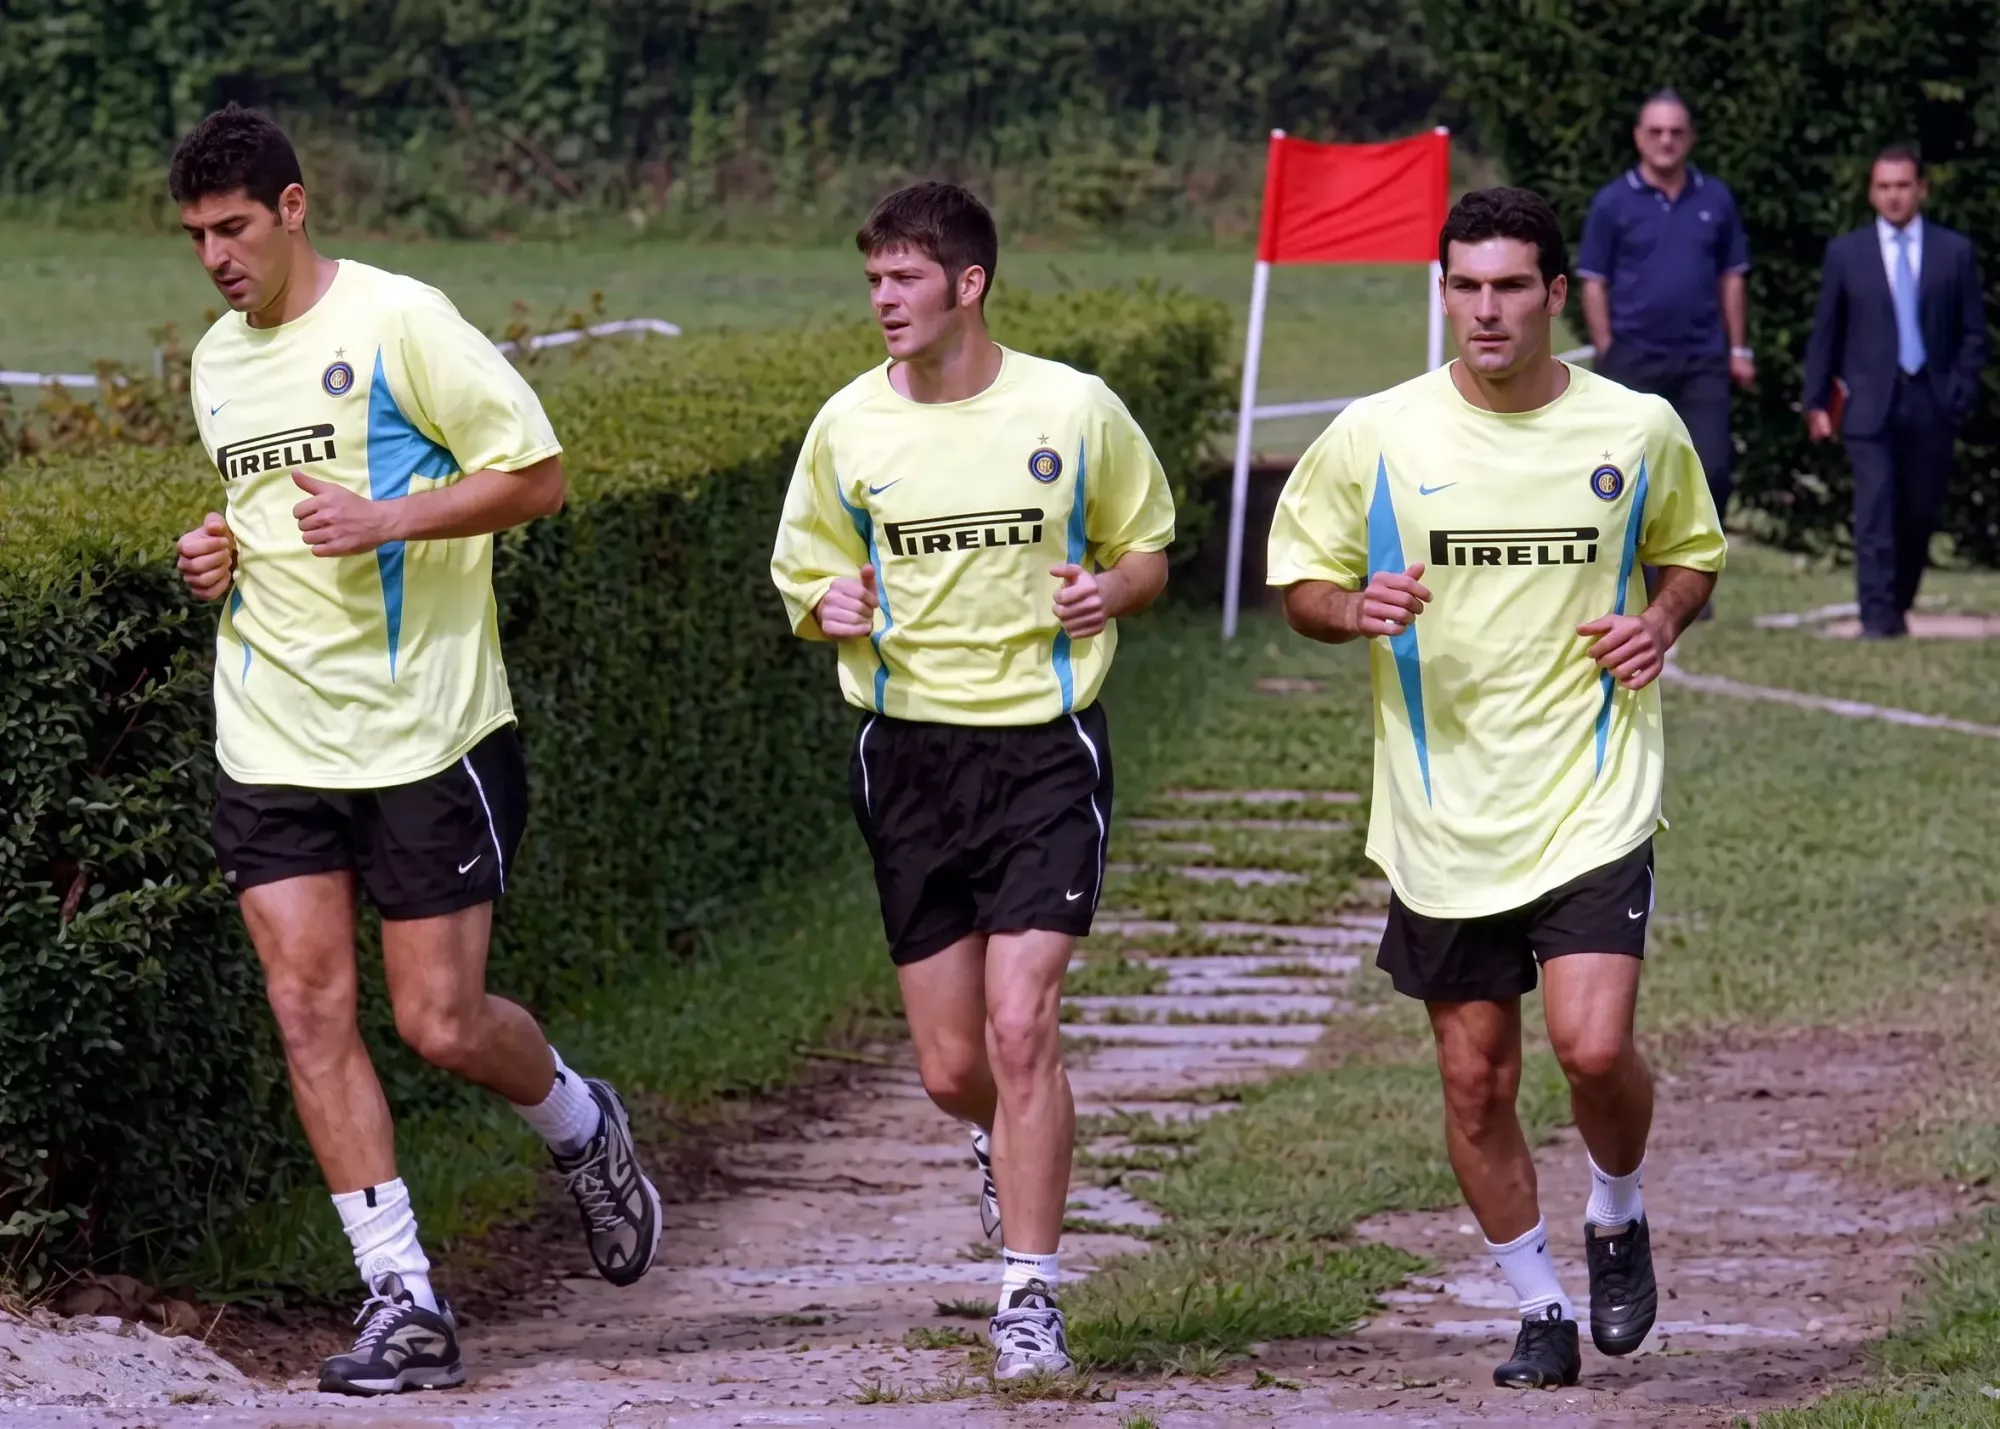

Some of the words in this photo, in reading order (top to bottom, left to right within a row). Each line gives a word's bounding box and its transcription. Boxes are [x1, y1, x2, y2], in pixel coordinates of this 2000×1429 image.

[217, 423, 337, 482] PIRELLI
[884, 508, 1045, 556] PIRELLI
[1429, 527, 1600, 566] PIRELLI
